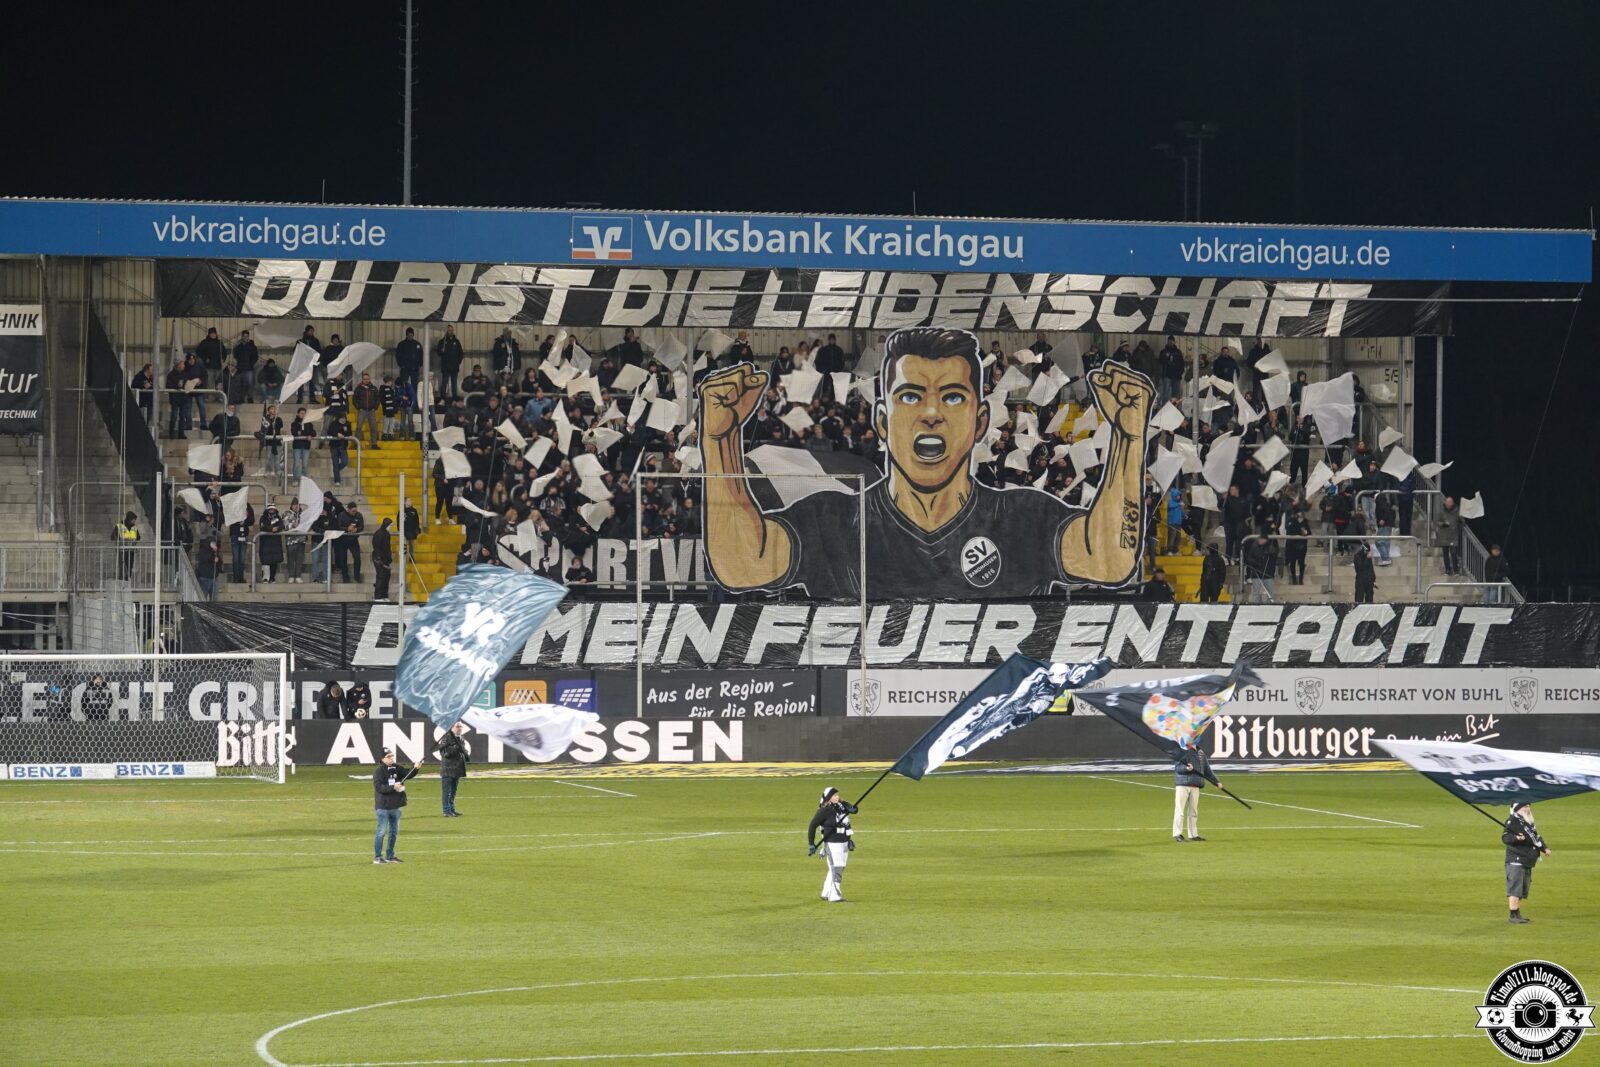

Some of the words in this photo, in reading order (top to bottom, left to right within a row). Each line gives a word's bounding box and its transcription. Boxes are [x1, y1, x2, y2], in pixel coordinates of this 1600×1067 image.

[153, 215, 386, 251] vbkraichgau.de
[644, 219, 832, 254] Volksbank
[844, 225, 1024, 266] Kraichgau
[1180, 239, 1391, 271] vbkraichgau.de
[241, 259, 374, 317] DU
[381, 261, 596, 325] BIST
[601, 268, 746, 327] DIE
[751, 268, 1373, 337] LEIDENSCHAFT
[965, 540, 987, 565] SV
[981, 567, 995, 581] 1916
[520, 602, 737, 666] MEIN
[743, 602, 1037, 665] FEUER
[1051, 602, 1515, 666] ENTFACHT
[646, 687, 678, 705] Aus
[684, 682, 713, 701] der
[719, 678, 775, 701] Region
[888, 690, 970, 704] REICHSRA
[1246, 689, 1288, 702] BUHL
[1330, 688, 1417, 701] REICHSRAT
[1422, 688, 1456, 701] VON
[1462, 688, 1503, 701] BUHL
[1544, 688, 1600, 701] REICHS
[688, 706, 715, 718] für
[720, 702, 747, 718] die
[753, 694, 817, 718] Region!
[1210, 715, 1376, 759] Bitburger
[1466, 714, 1499, 736] Bit
[13, 766, 67, 778] BENZ
[116, 764, 170, 776] BENZ
